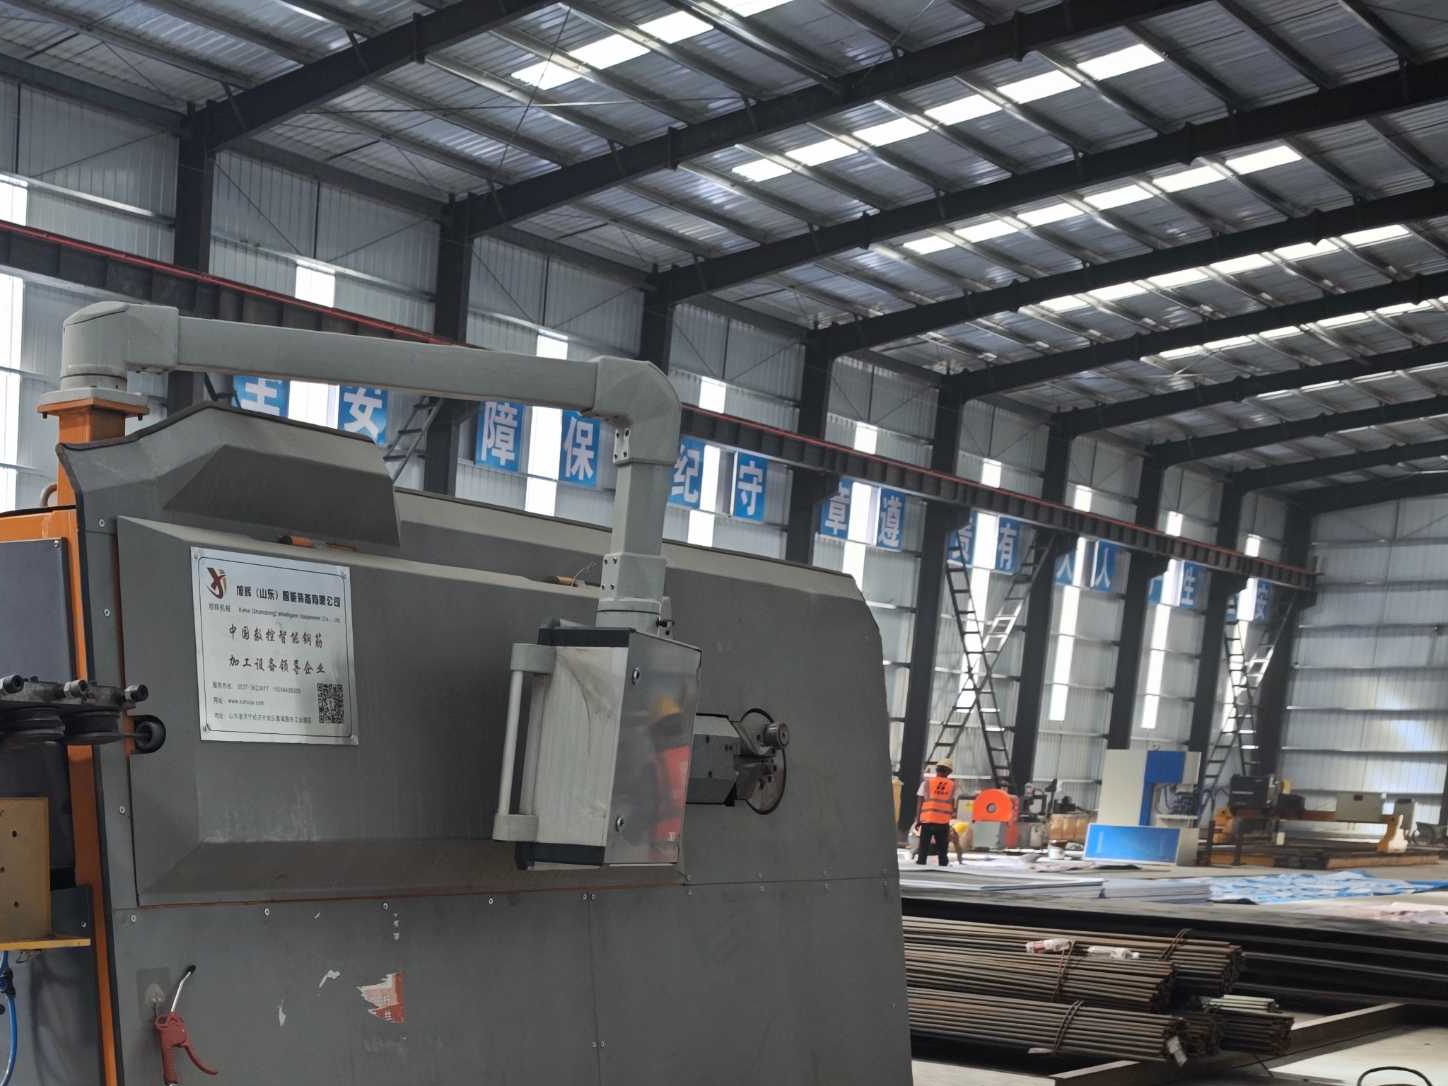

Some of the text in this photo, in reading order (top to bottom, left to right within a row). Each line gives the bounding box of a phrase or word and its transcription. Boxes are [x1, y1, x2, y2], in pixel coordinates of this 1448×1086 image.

[481, 401, 518, 466] 障
[564, 415, 594, 480] 保
[671, 443, 701, 503] 纪
[737, 460, 763, 516] 守
